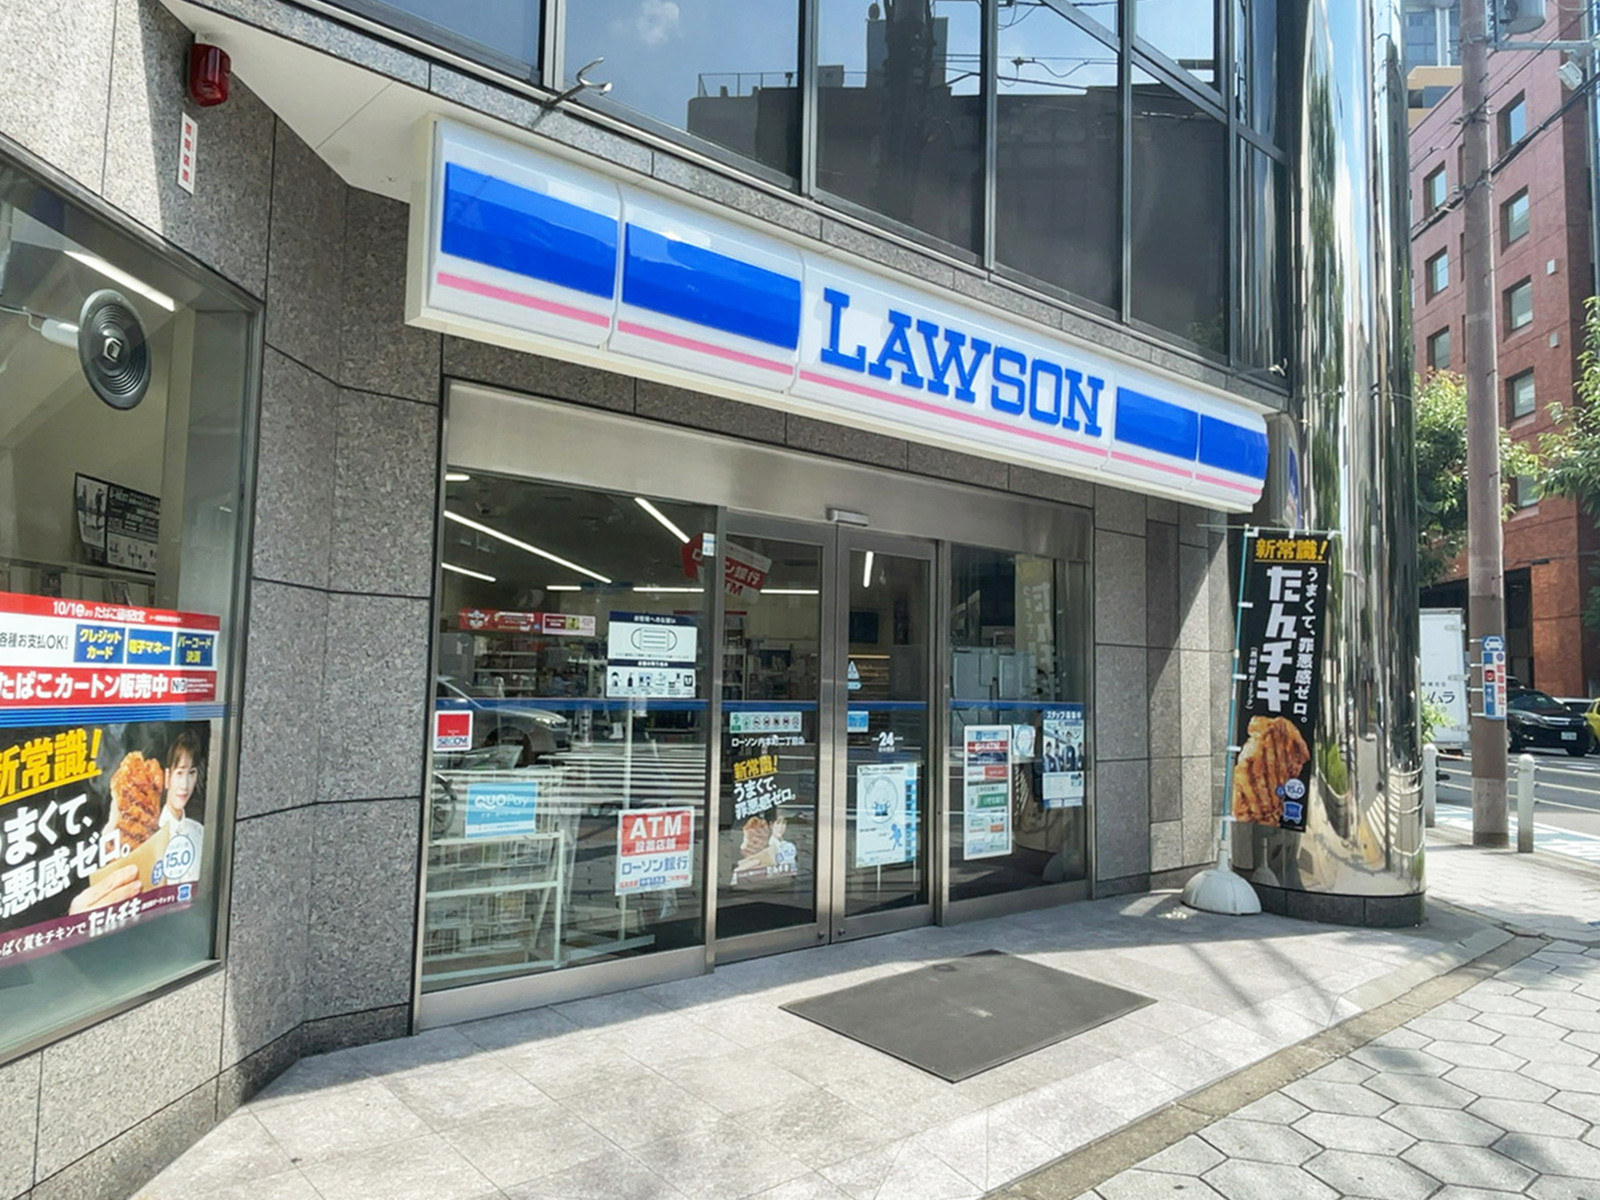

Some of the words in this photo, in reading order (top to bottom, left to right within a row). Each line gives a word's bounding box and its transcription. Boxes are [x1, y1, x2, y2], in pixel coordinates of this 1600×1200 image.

[821, 287, 1105, 438] LAWSON
[1256, 539, 1328, 560] 新常識!
[80, 628, 122, 644] クレジット
[128, 639, 171, 654] 電子マネー
[1257, 566, 1302, 712] たんチキ
[86, 645, 114, 660] カード
[0, 669, 168, 700] たばこカートン販売中
[734, 776, 777, 802] うまくて、
[0, 793, 93, 866] まくて、
[629, 814, 683, 840] ATM
[166, 850, 191, 868] 15.0
[622, 856, 688, 875] ローソン銀行
[0, 828, 131, 919] 悪感ゼロ。
[88, 897, 142, 938] たんチキ
